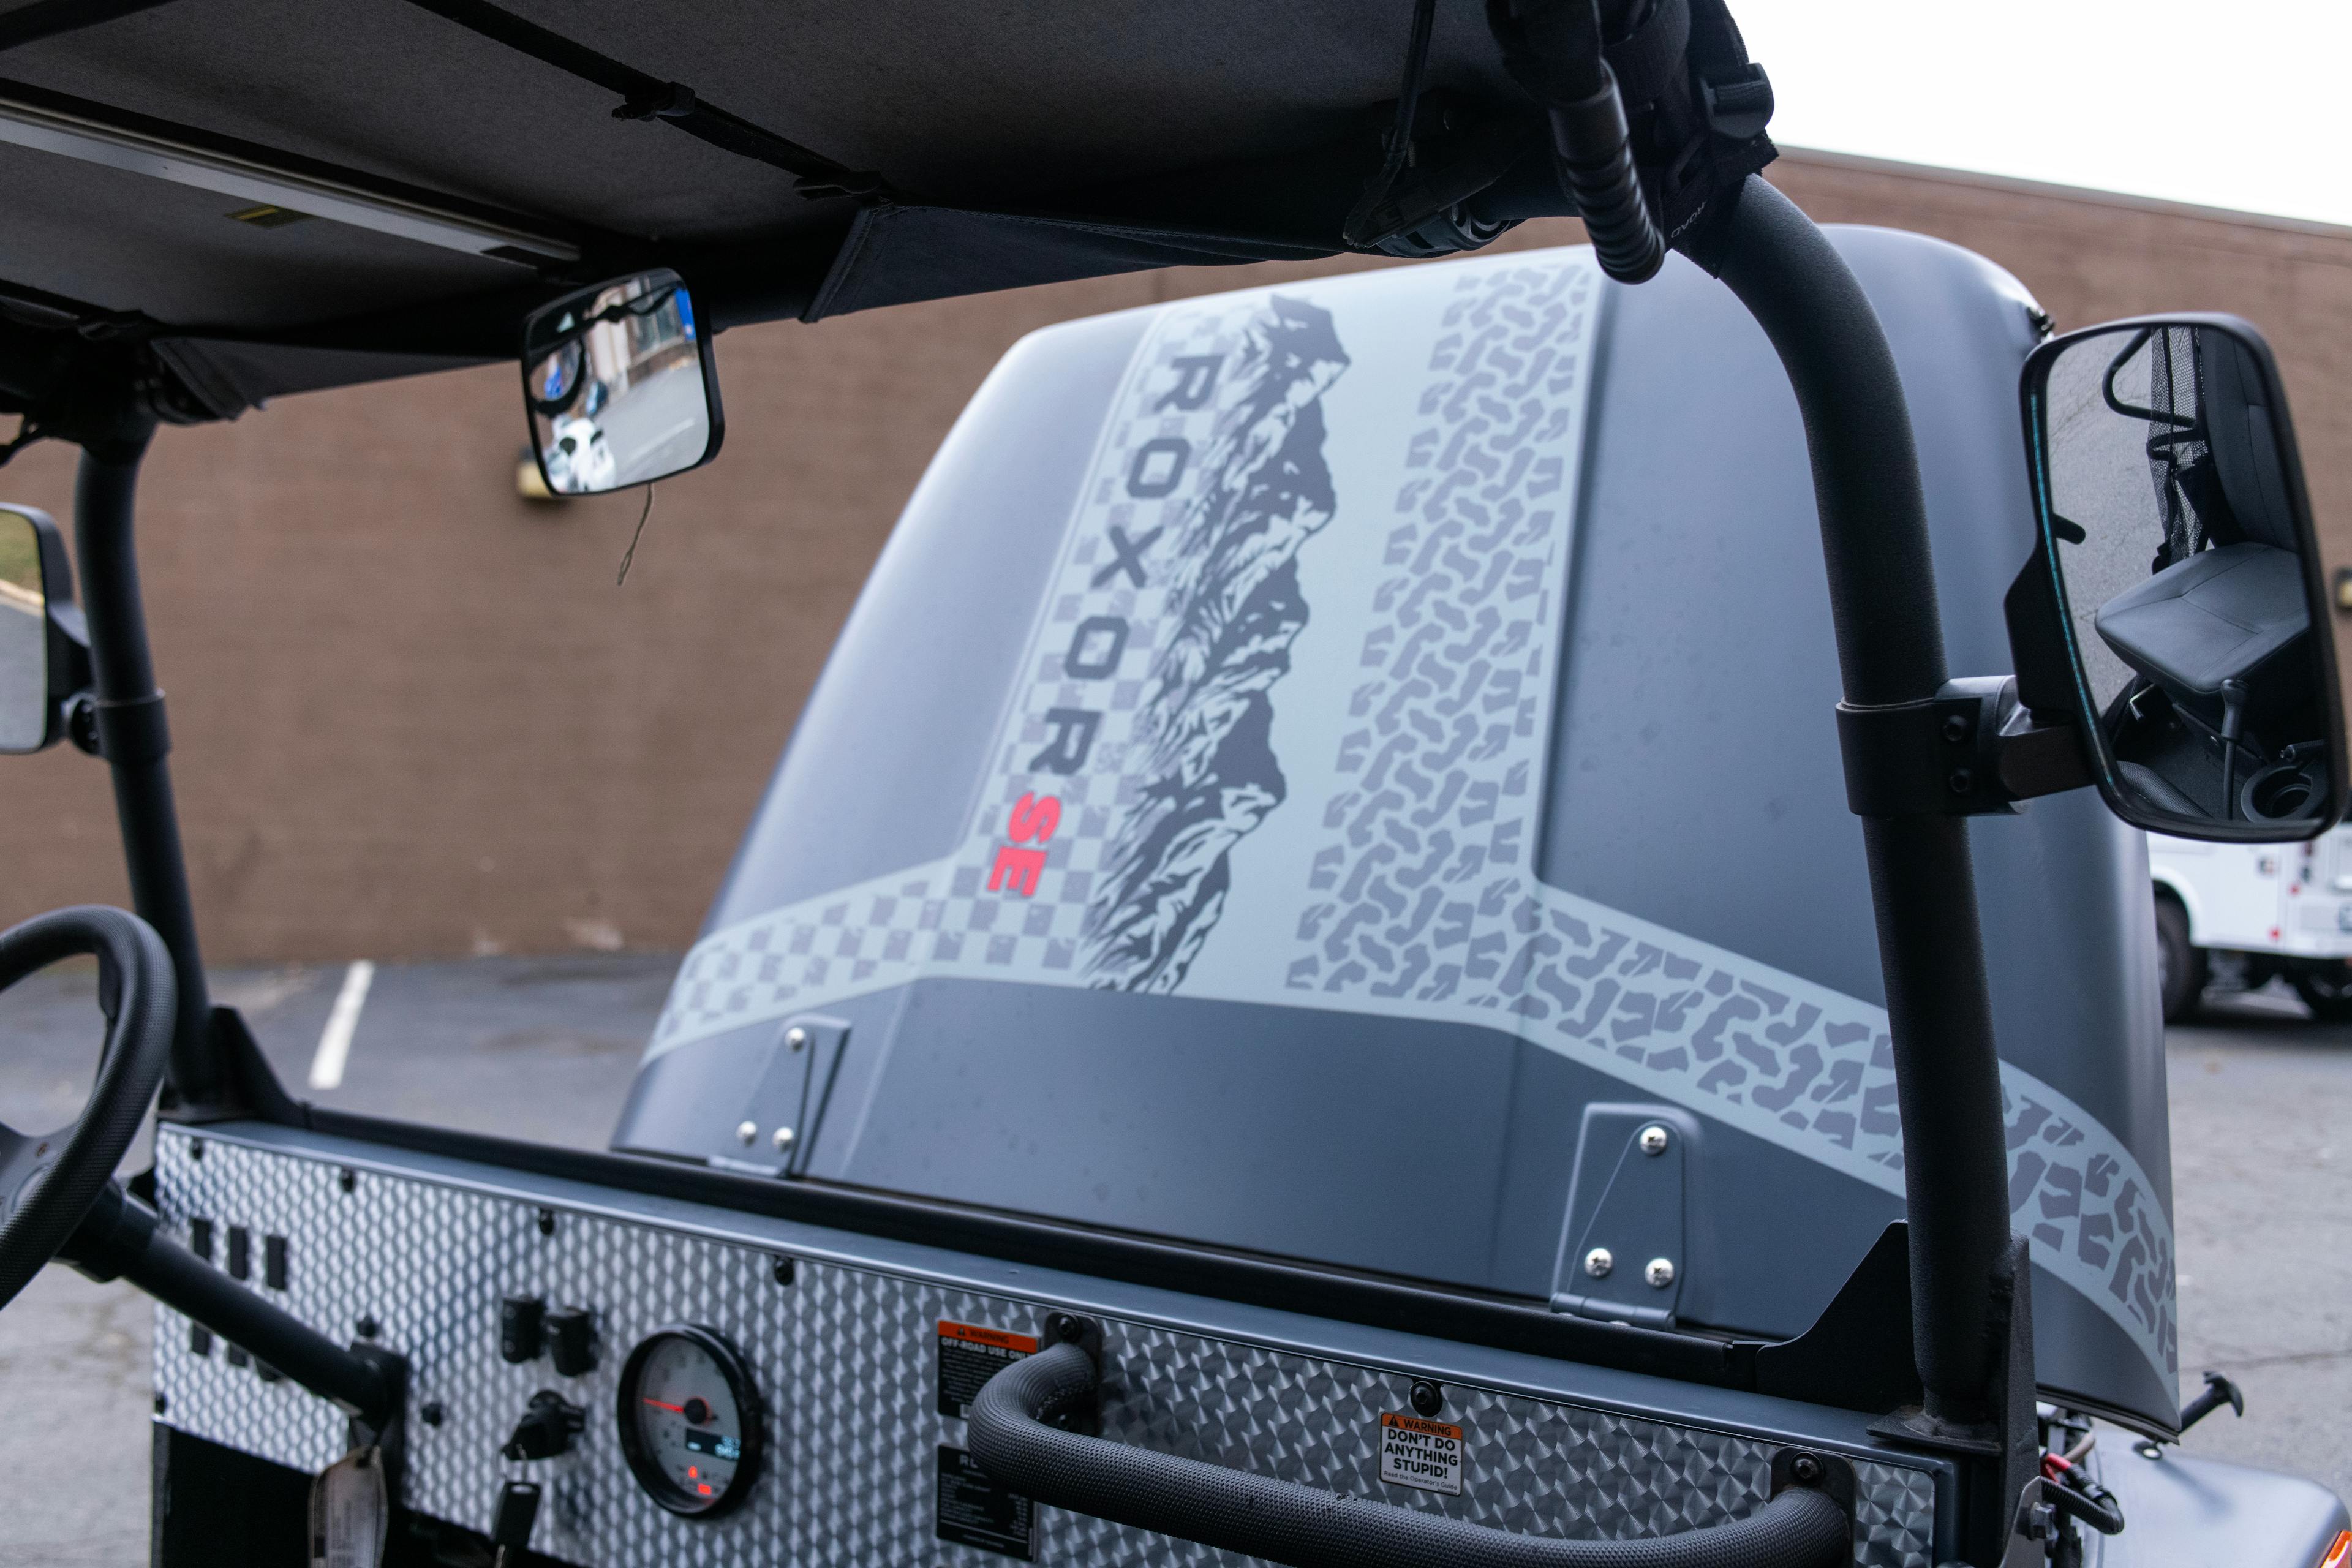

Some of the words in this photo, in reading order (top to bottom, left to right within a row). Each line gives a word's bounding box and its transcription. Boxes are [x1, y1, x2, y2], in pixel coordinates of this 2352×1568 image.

[1029, 355, 1224, 776] ROXOR
[987, 792, 1062, 899] SE
[987, 1345, 1008, 1357] USE
[1404, 1419, 1452, 1436] WARNING
[1388, 1428, 1431, 1447] DON'T
[1434, 1437, 1456, 1451] DO
[1384, 1442, 1458, 1466] ANYTHING
[1393, 1458, 1448, 1479] STUPID!
[1441, 1482, 1458, 1490] Guide
